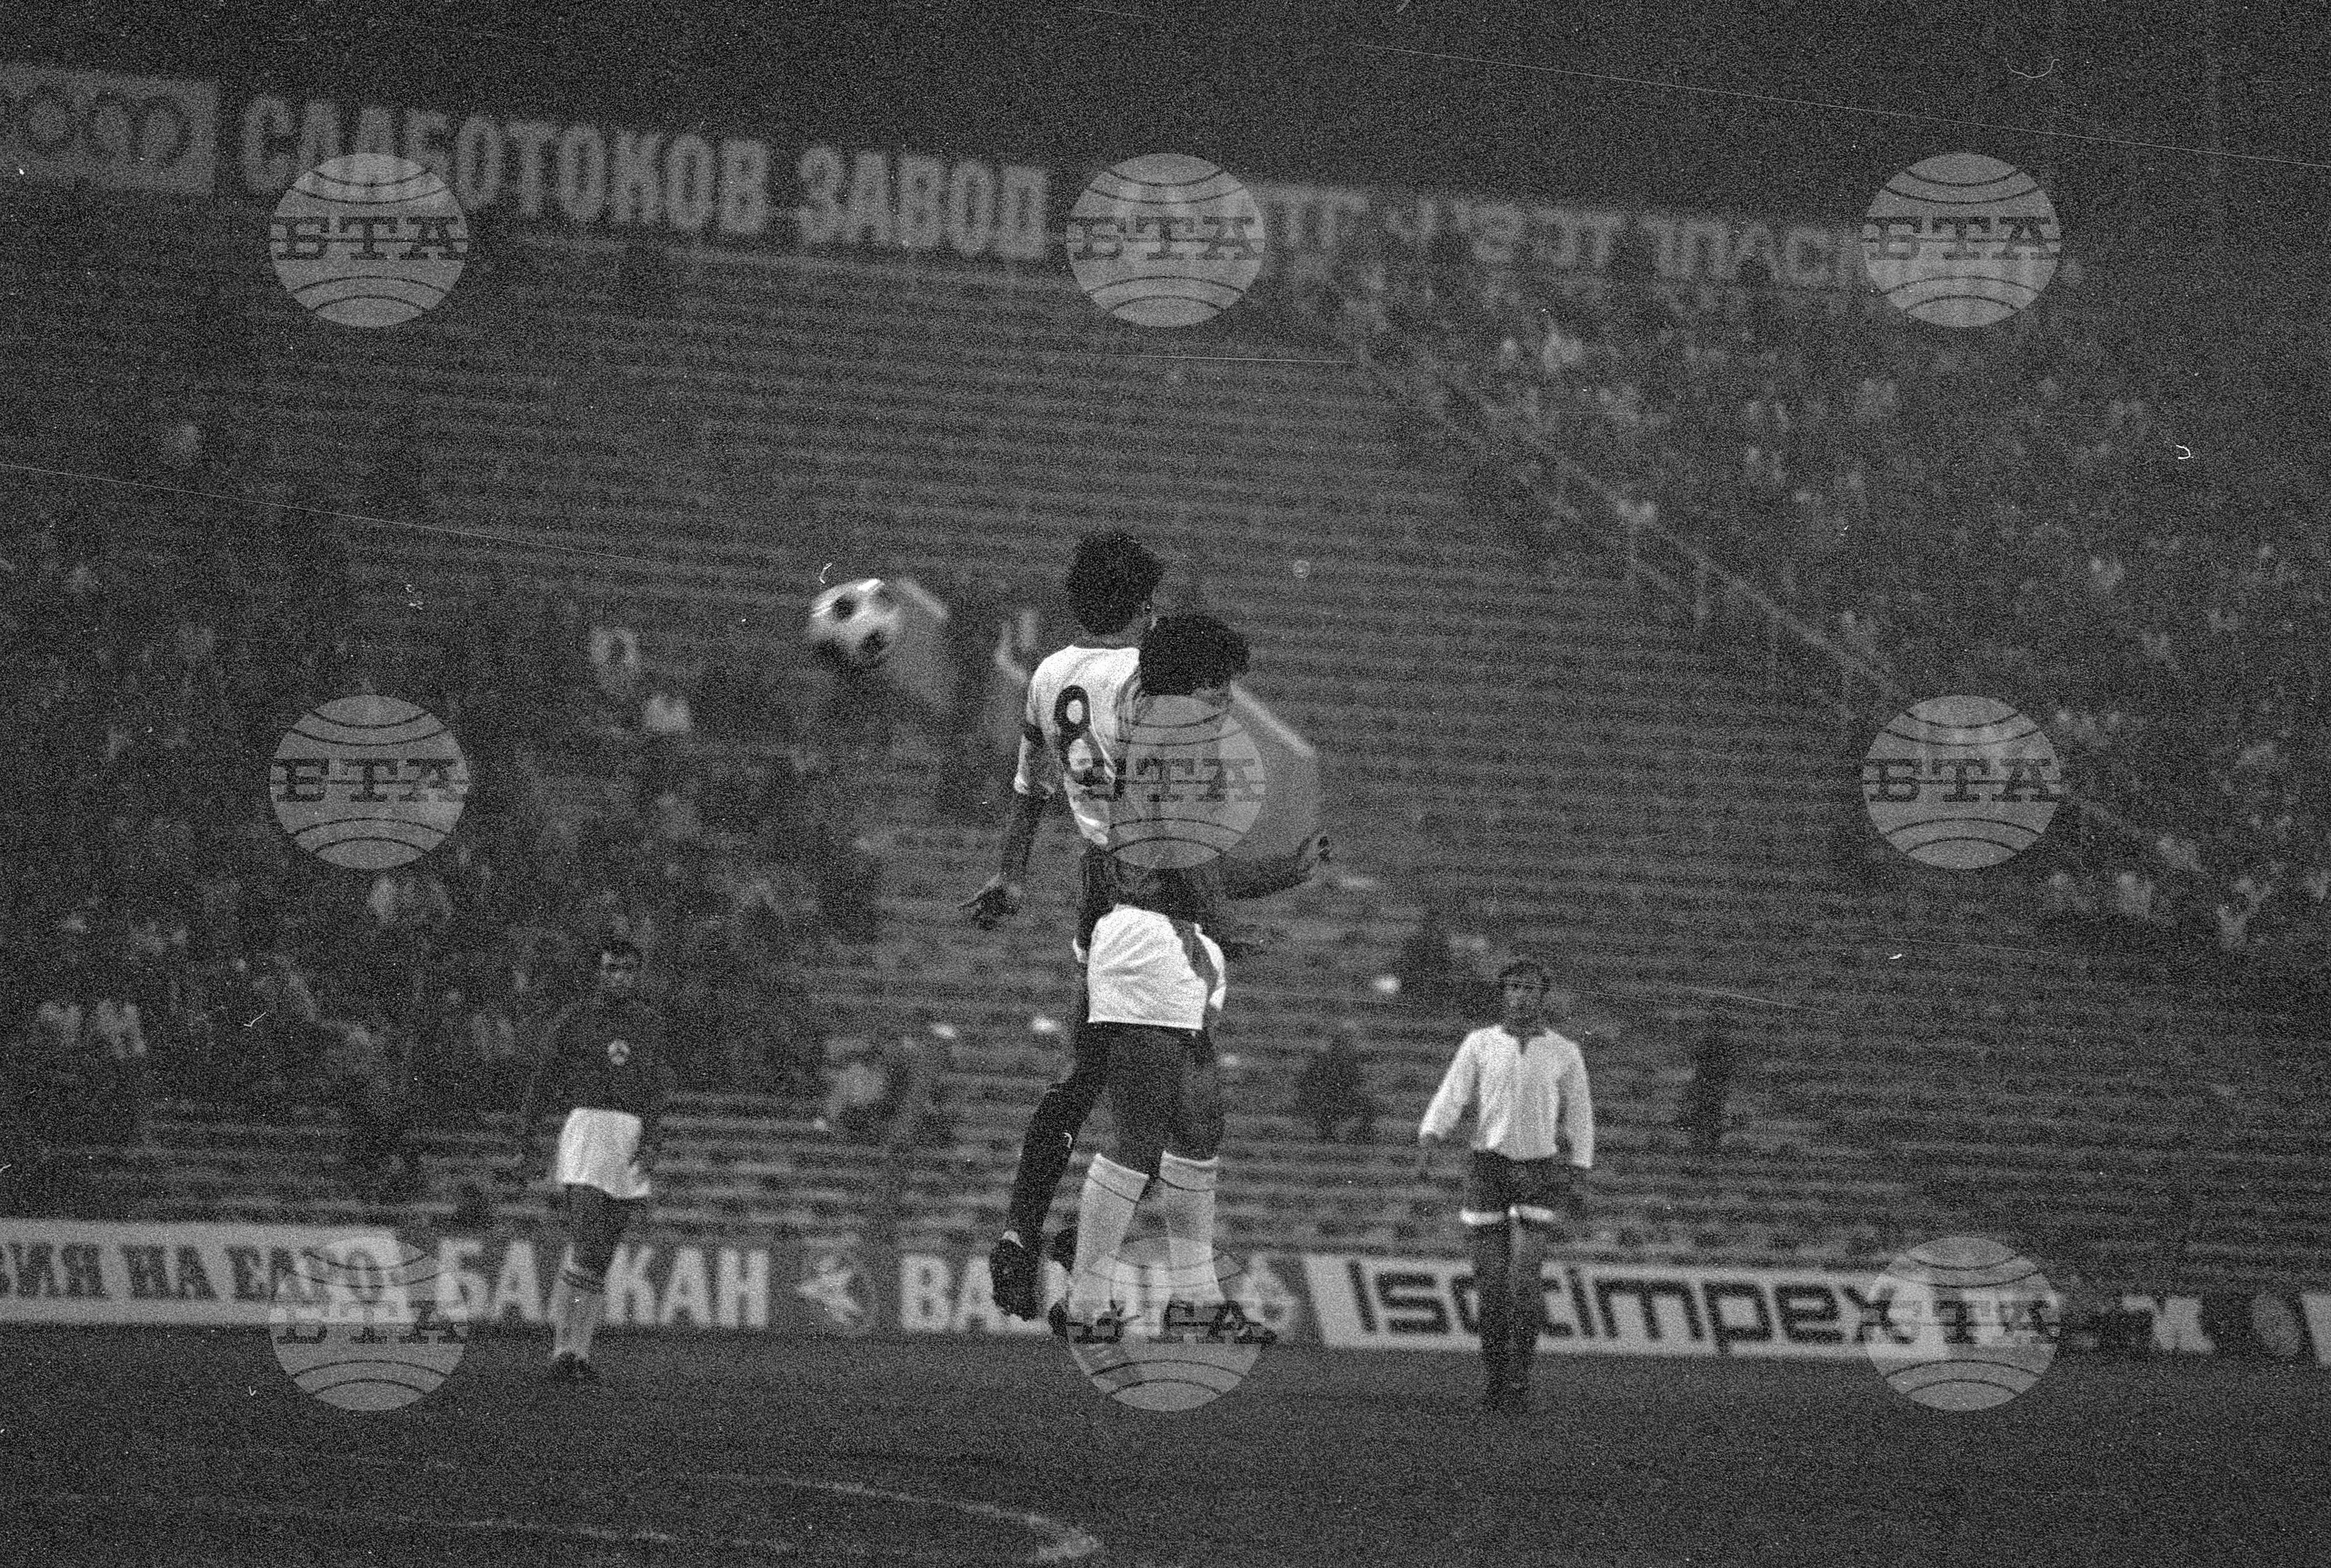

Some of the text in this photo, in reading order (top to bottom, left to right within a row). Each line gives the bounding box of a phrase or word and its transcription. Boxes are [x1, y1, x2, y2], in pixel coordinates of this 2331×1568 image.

[795, 145, 1047, 260] ЗАВОД
[1054, 684, 1106, 784] 8
[118, 1242, 220, 1300] НА
